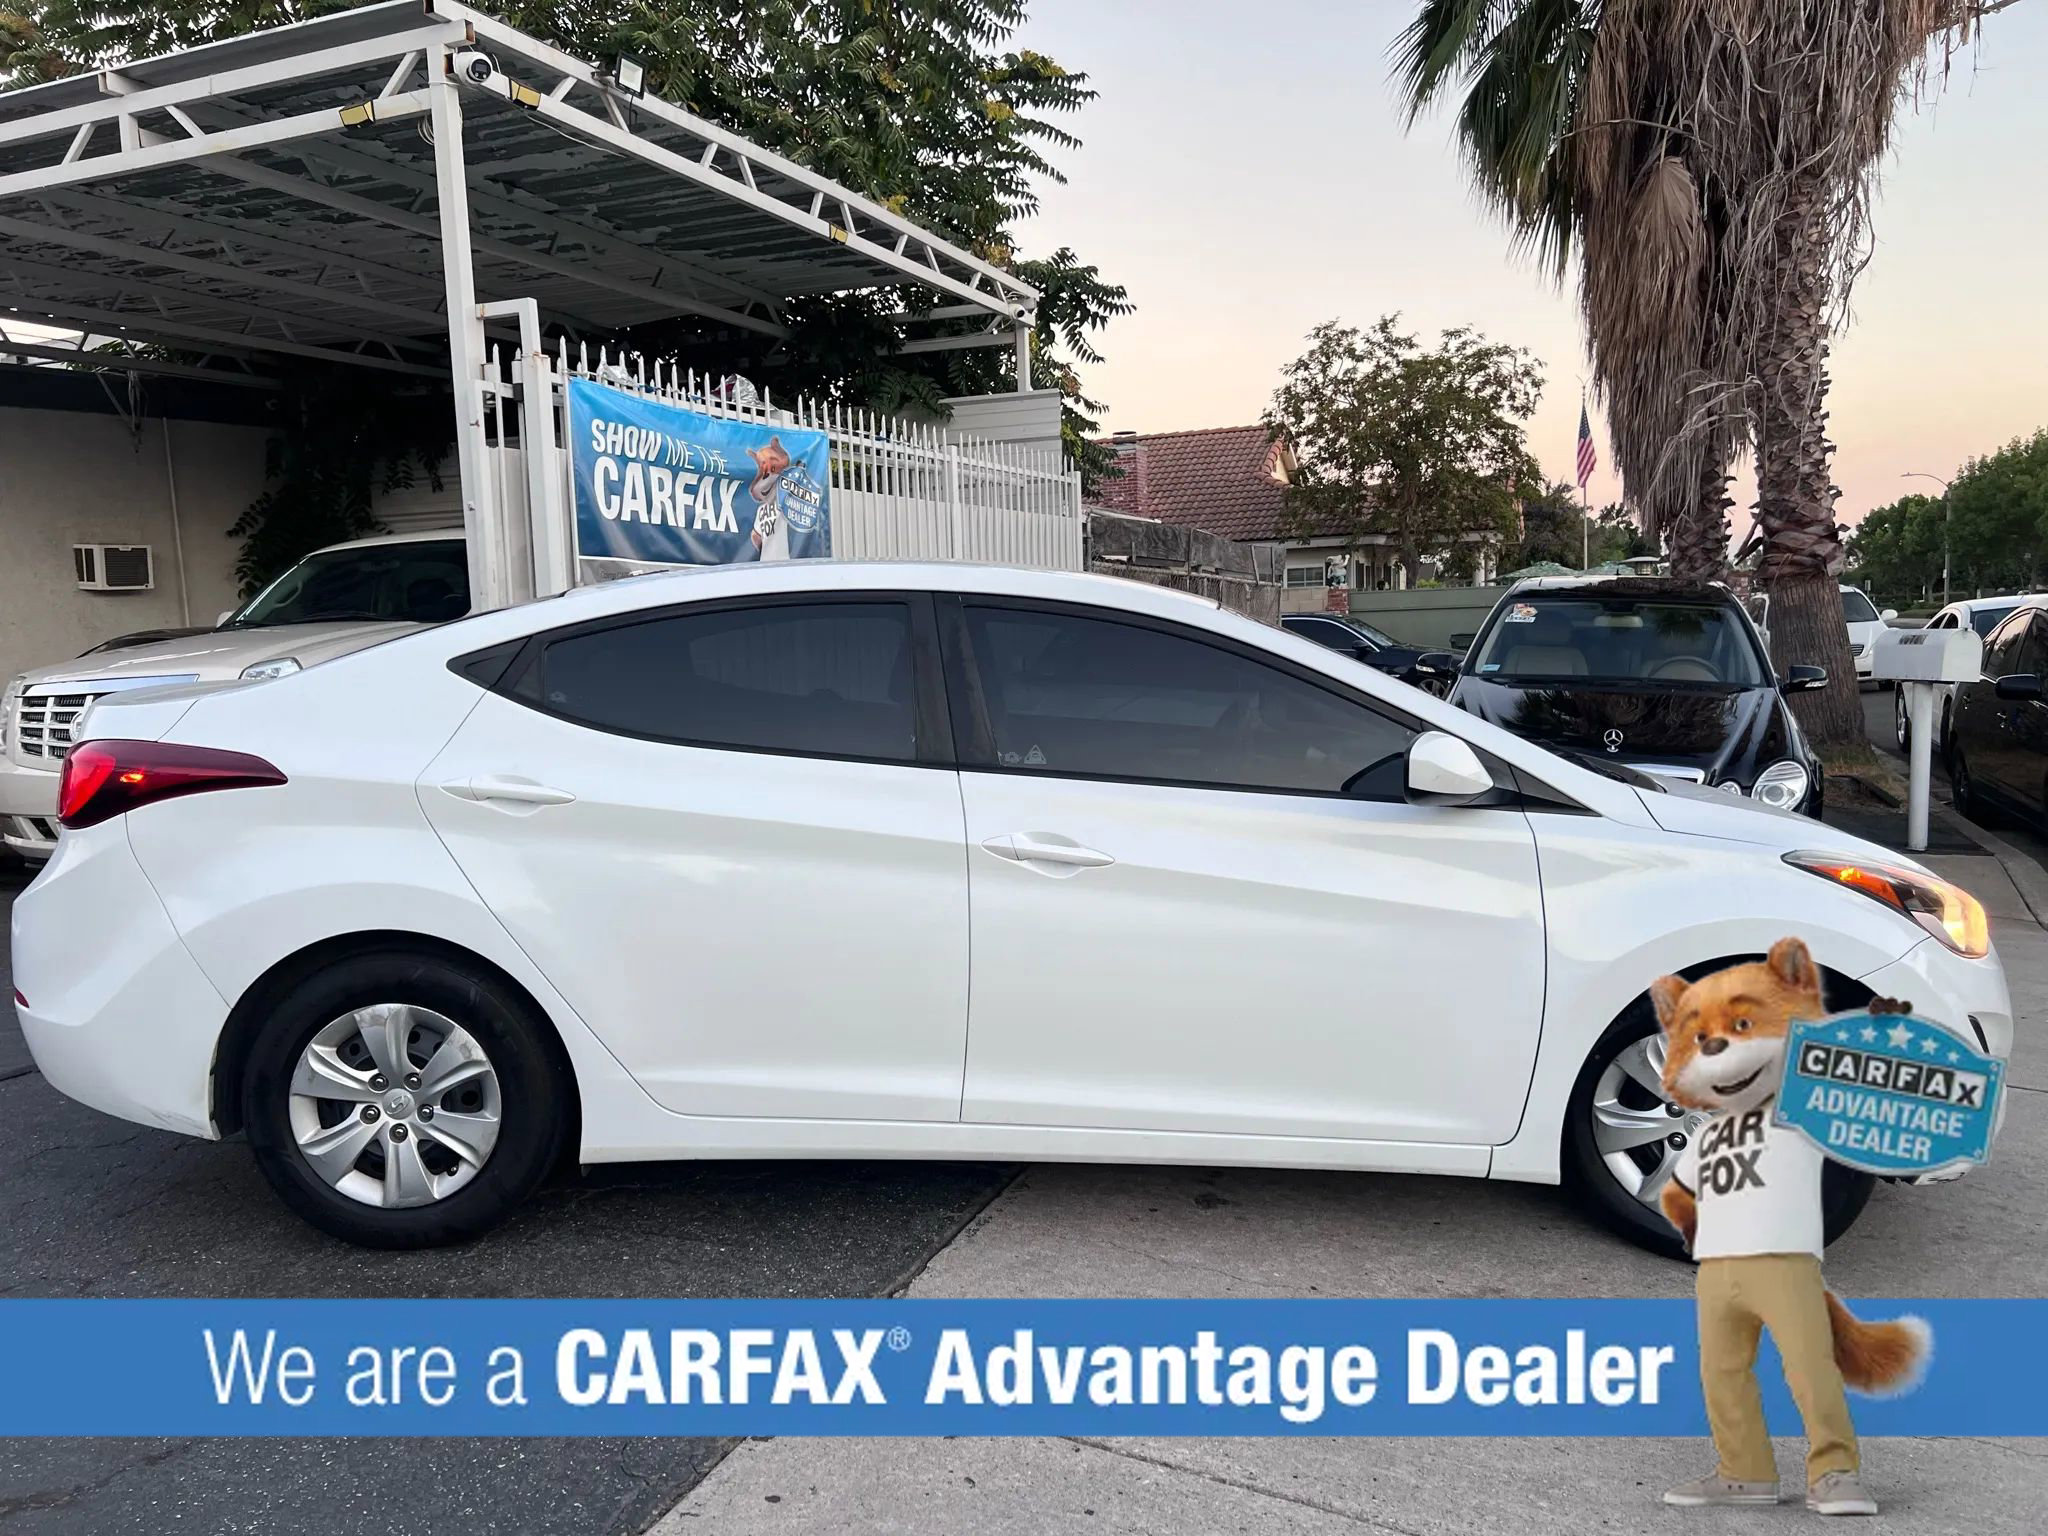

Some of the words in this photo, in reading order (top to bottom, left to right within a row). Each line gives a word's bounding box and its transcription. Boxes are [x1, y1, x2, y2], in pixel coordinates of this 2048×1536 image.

[591, 418, 662, 462] SHOW
[665, 435, 695, 470] ME
[694, 444, 730, 476] THE
[593, 457, 741, 533] CARFAX
[760, 519, 776, 536] FOX
